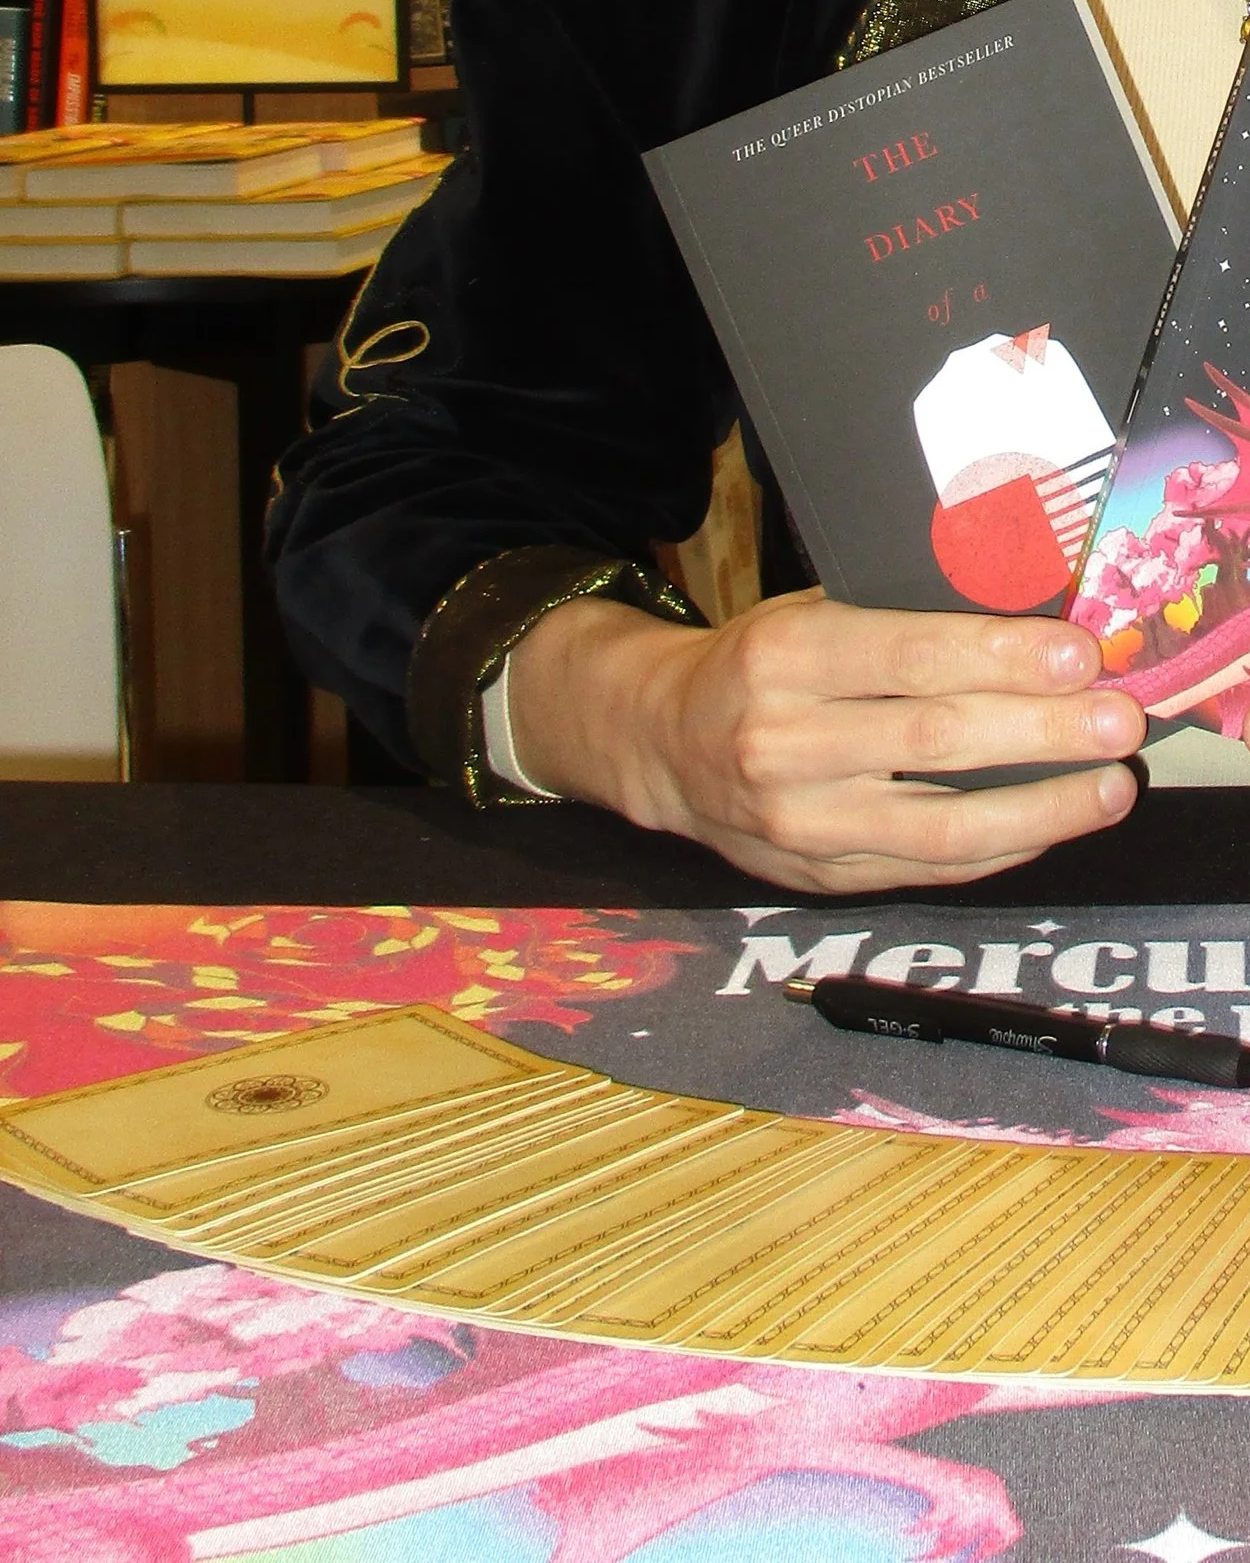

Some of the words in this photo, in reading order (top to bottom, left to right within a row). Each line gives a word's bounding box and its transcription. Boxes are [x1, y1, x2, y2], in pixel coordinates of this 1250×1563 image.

[733, 139, 767, 163] THE
[769, 115, 824, 149] QUEER
[827, 76, 914, 124] DYSTOPIAN
[917, 35, 1016, 87] BESTSELLER
[853, 130, 939, 185] THE
[864, 193, 982, 263] DIARY
[926, 287, 955, 326] of
[972, 281, 989, 302] a
[988, 1027, 1058, 1054] Sharpie
